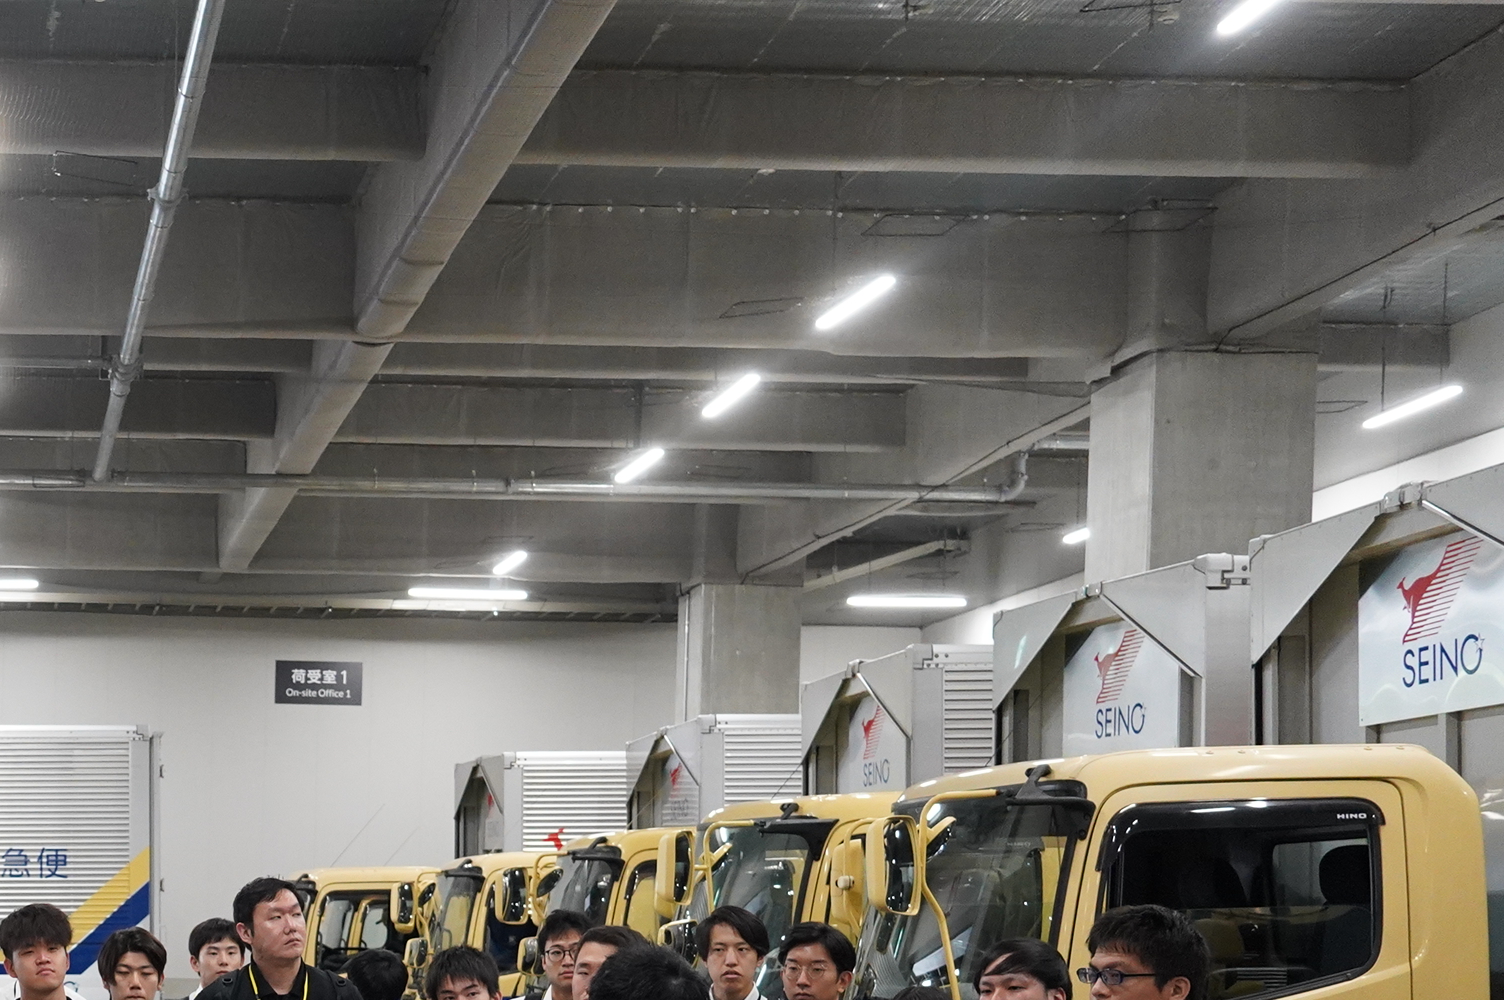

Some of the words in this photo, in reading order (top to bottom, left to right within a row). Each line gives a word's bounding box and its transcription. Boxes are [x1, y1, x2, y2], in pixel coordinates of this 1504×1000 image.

[1402, 633, 1484, 688] SEINO
[285, 688, 317, 698] On-site
[318, 688, 344, 698] Office
[346, 689, 351, 698] 1
[1095, 703, 1145, 739] SEINO
[863, 759, 890, 787] SEINO
